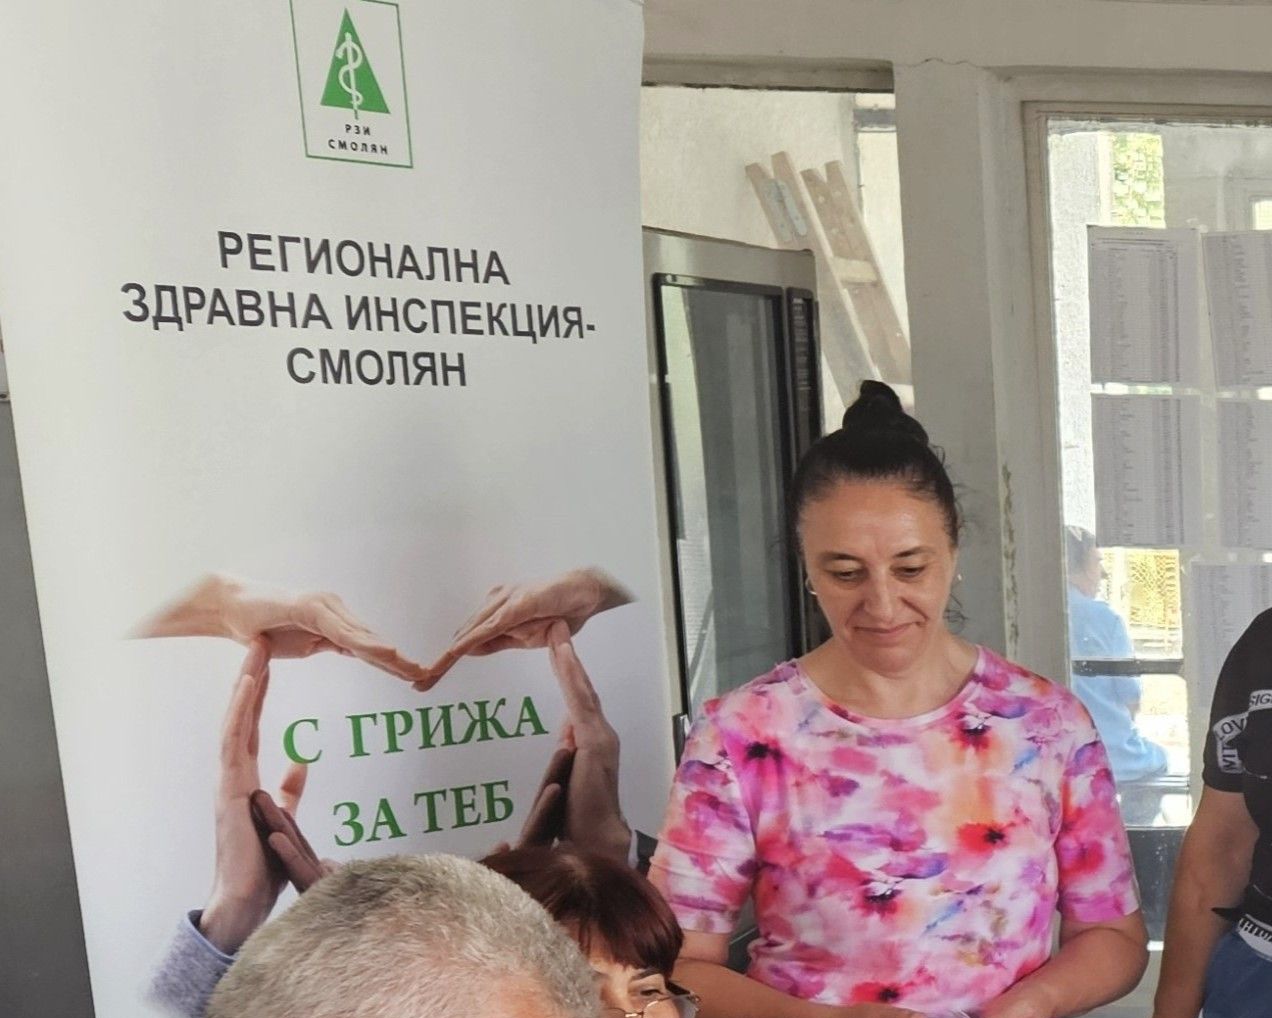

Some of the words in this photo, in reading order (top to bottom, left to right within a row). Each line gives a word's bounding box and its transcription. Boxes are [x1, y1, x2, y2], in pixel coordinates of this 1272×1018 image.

[328, 139, 388, 155] СМОЛЯН
[345, 124, 370, 136] РЗИ
[217, 230, 511, 286] РЕГИОНАЛНА
[120, 282, 333, 331] ЗДРАВНА
[345, 294, 596, 344] ИНСПЕКЦИЯ-
[286, 347, 467, 387] СМОЛЯН
[282, 718, 323, 764] С
[345, 696, 549, 758] ГРИЖА
[332, 798, 408, 847] ЗА
[413, 780, 514, 834] ТЕБ
